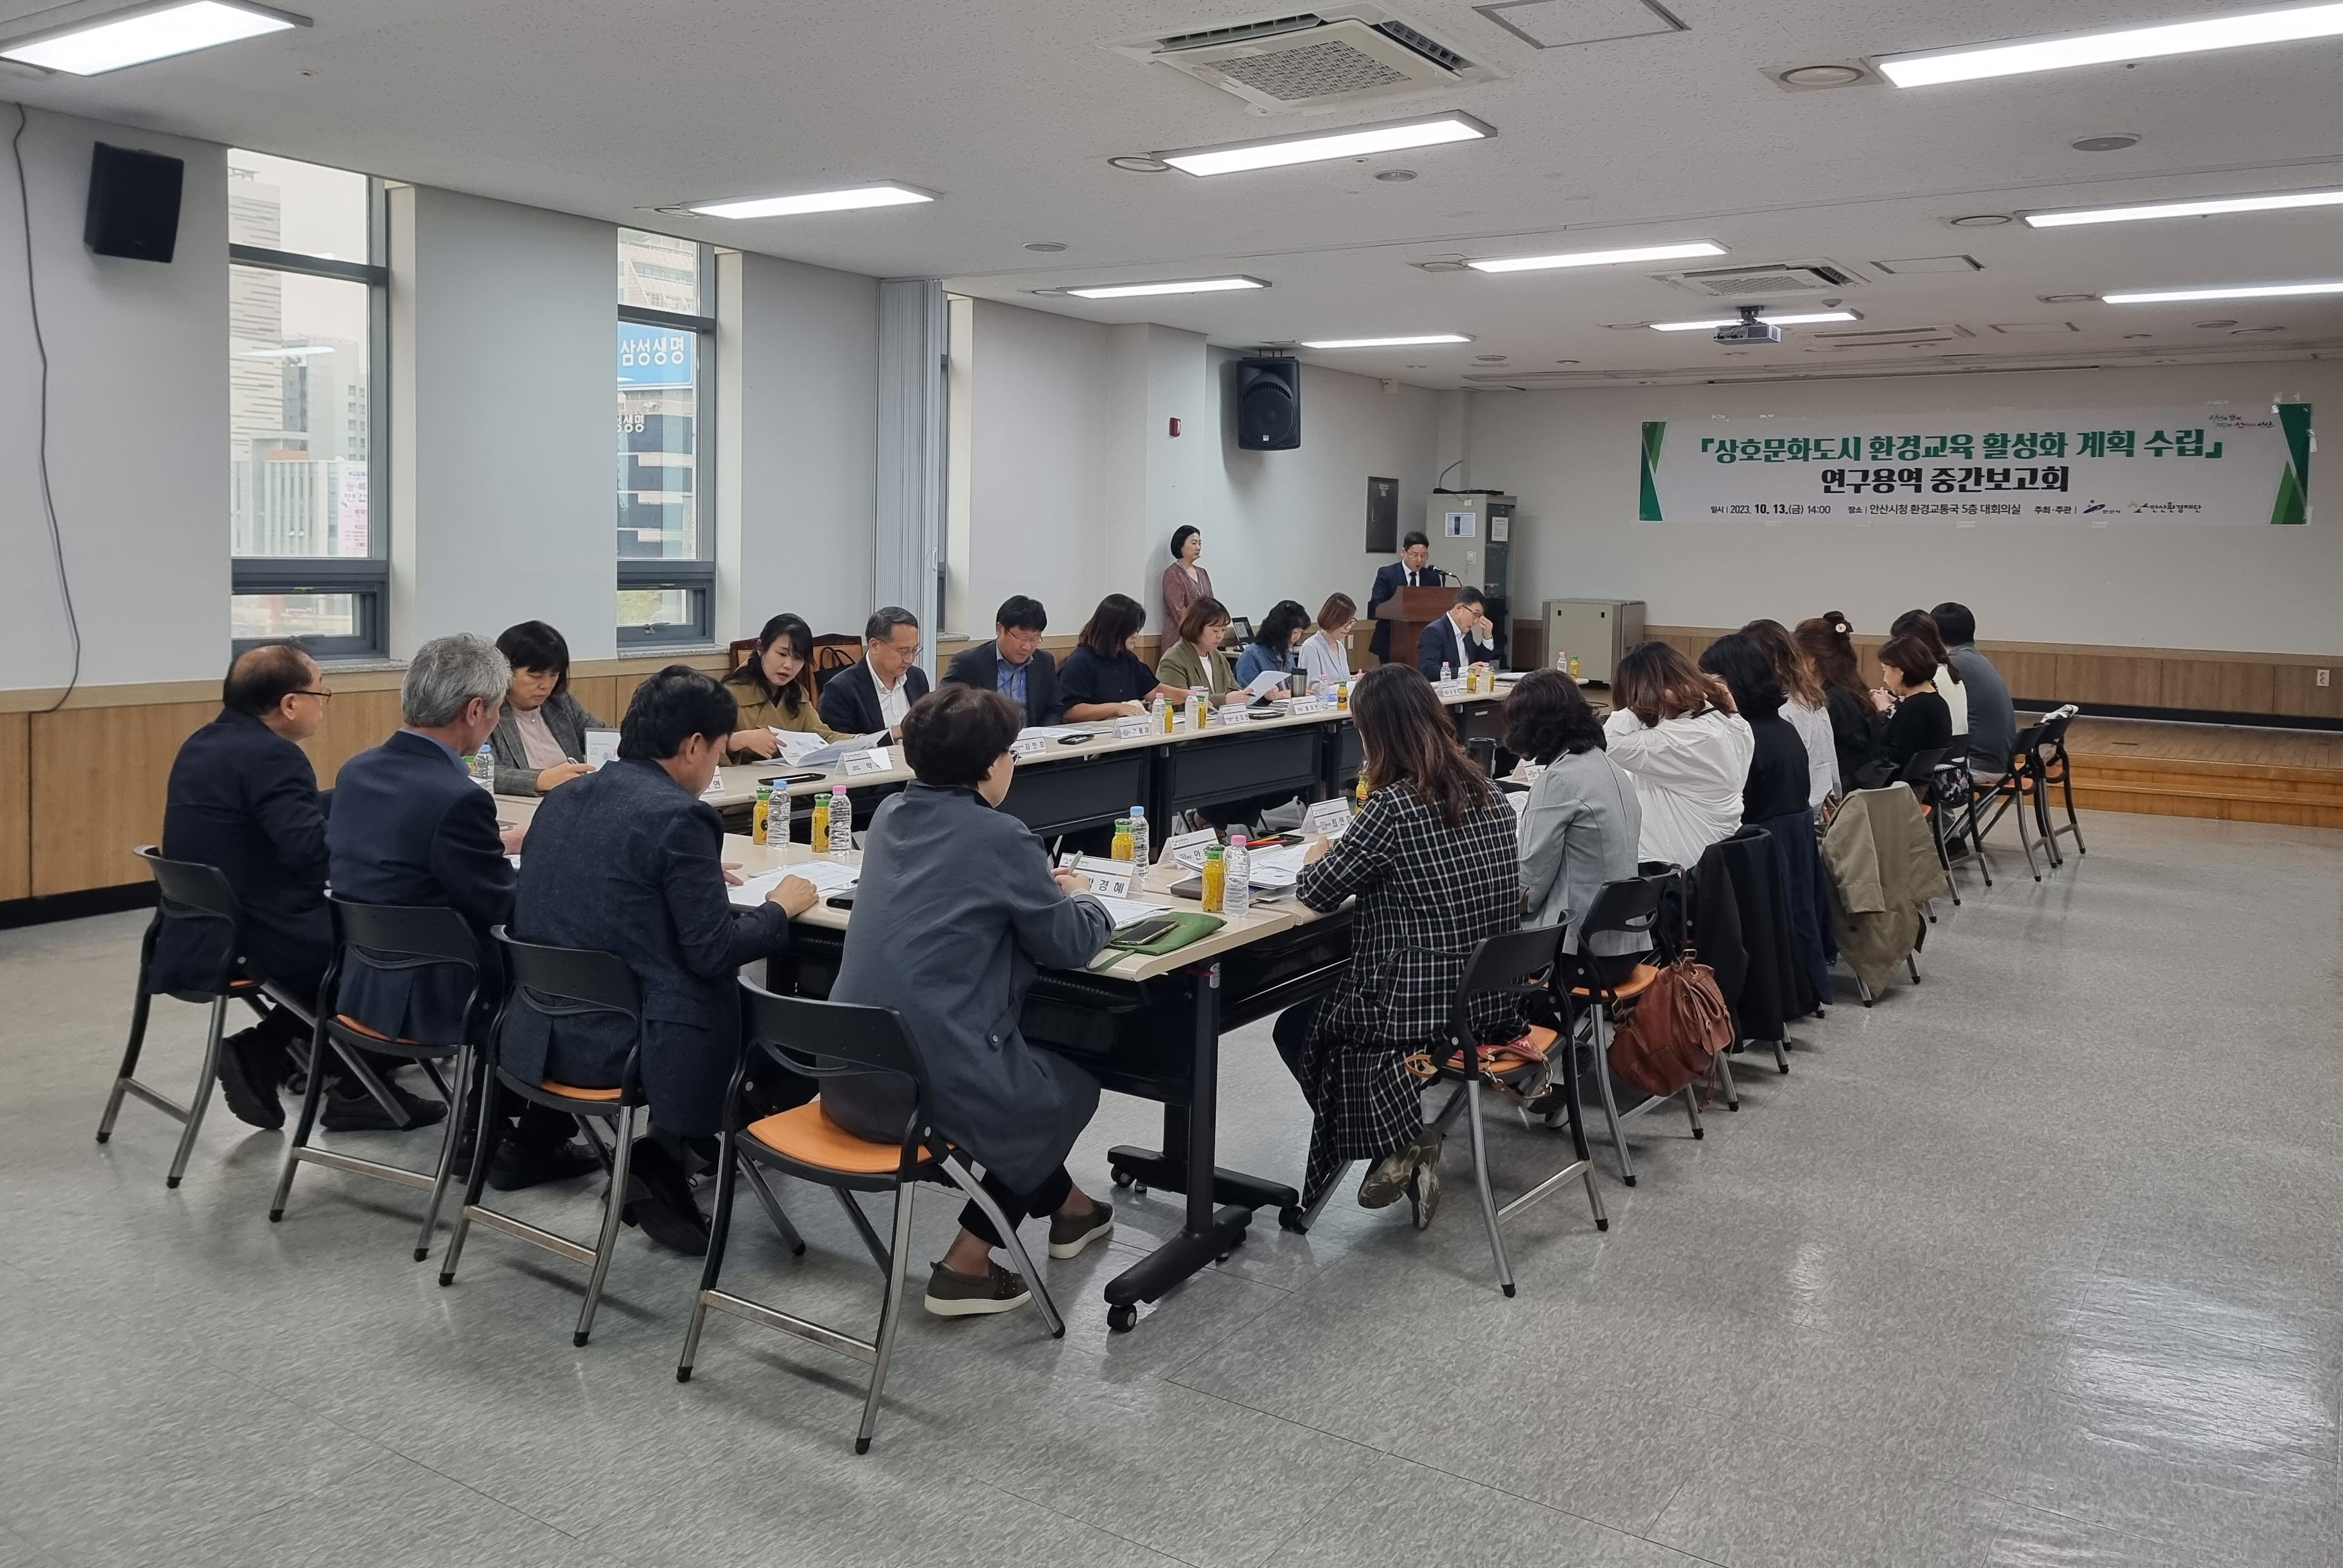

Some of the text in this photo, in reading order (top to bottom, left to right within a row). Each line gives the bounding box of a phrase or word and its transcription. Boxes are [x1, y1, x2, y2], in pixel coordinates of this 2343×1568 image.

[620, 336, 685, 367] 삼성생명
[1701, 429, 2223, 463] 『상호문화도시 환경교육 활성화 계획 수립』
[1821, 465, 2069, 494] 연구용역 중간보고회
[1710, 505, 1724, 514] 일시
[1730, 505, 1752, 514] 2023.
[1754, 504, 1770, 514] 10.
[1808, 505, 1831, 514] 14:00
[1848, 505, 1863, 514] 장소
[1869, 504, 1908, 515] 안산시청
[1910, 504, 1960, 515] 환경교통국
[1962, 504, 1978, 515] 5층
[1980, 504, 2021, 515] 대회의실
[2150, 501, 2203, 513] 안산환경재단
